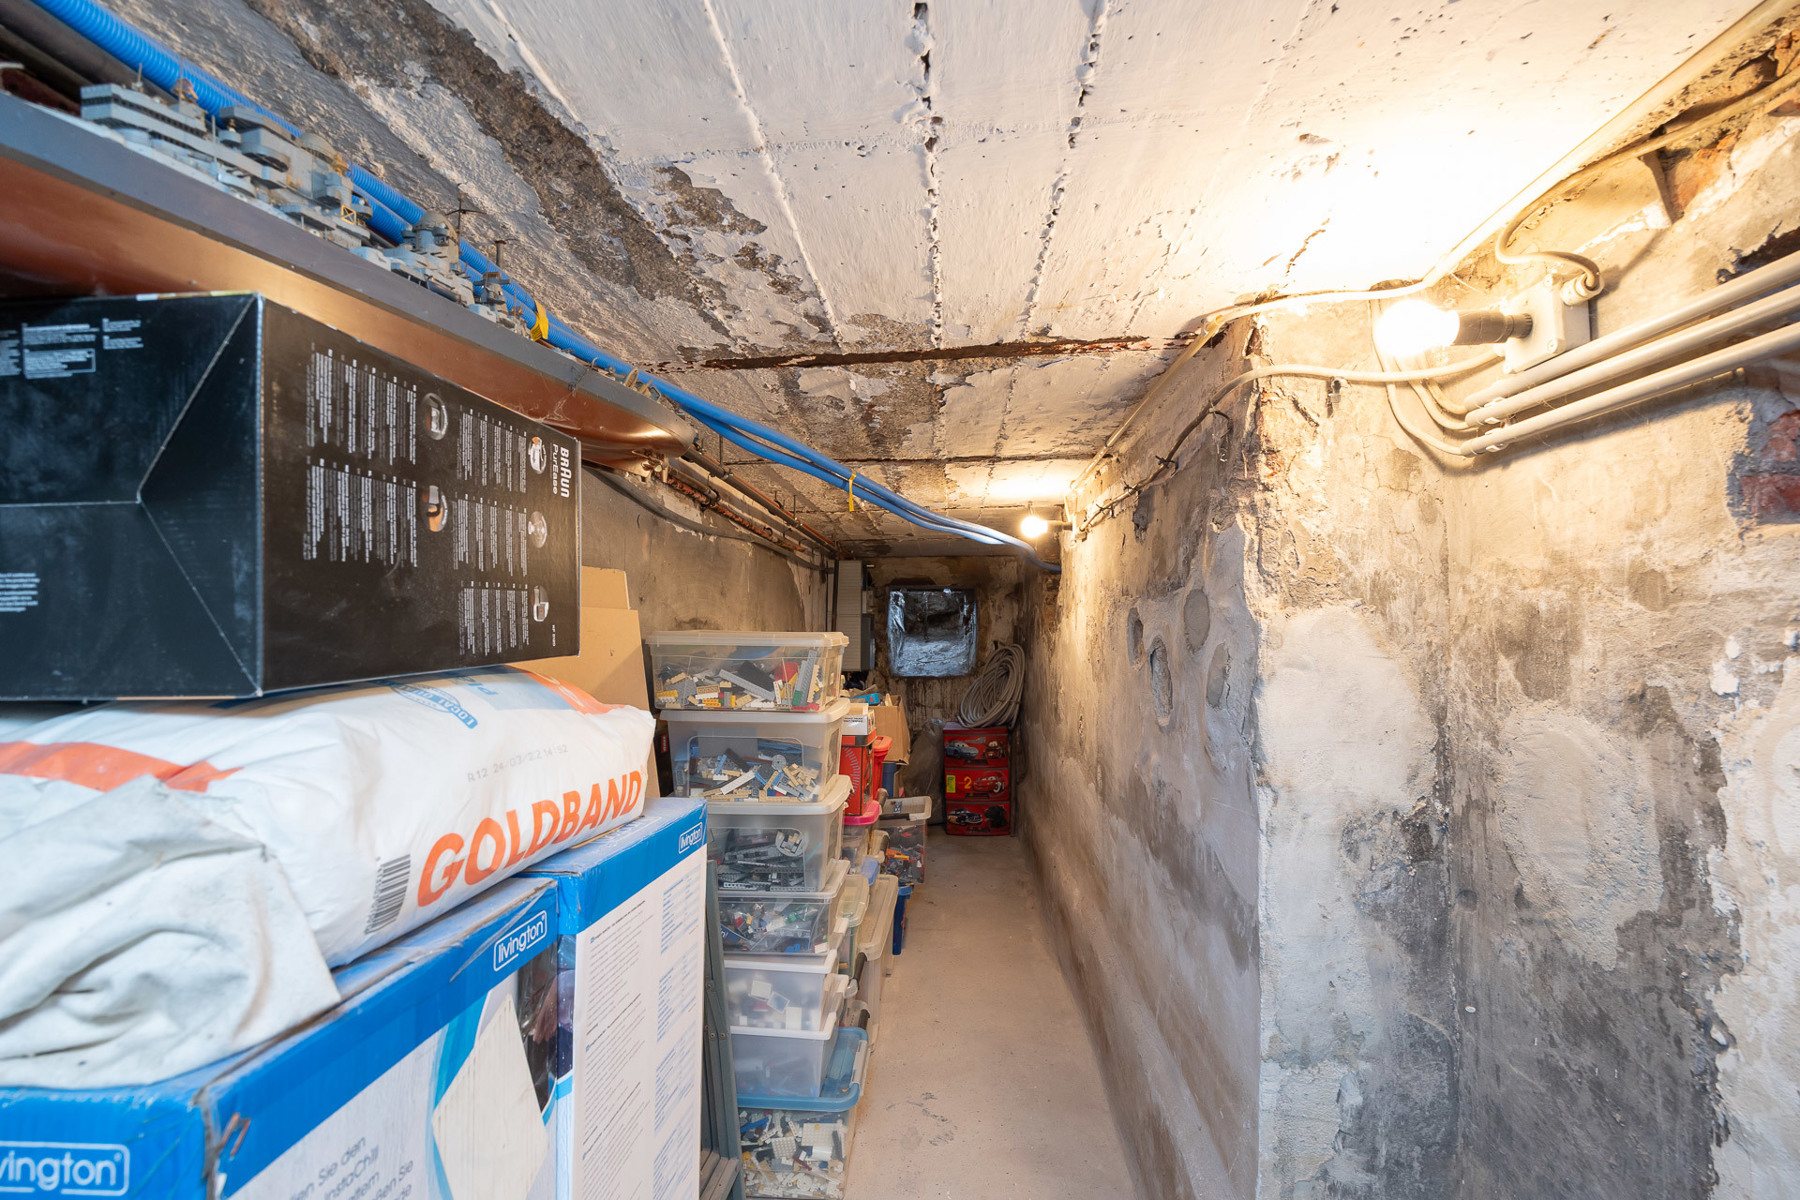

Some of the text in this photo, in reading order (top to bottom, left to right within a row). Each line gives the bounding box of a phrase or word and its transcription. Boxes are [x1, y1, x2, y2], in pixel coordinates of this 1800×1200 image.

[560, 446, 572, 498] BRAUN
[442, 701, 475, 726] LOCAL
[417, 770, 643, 908] GOLDBAND
[498, 921, 544, 964] livington
[0, 1150, 117, 1191] vington
[318, 1162, 338, 1187] Sie
[341, 1137, 366, 1166] den
[398, 1160, 414, 1182] Sie
